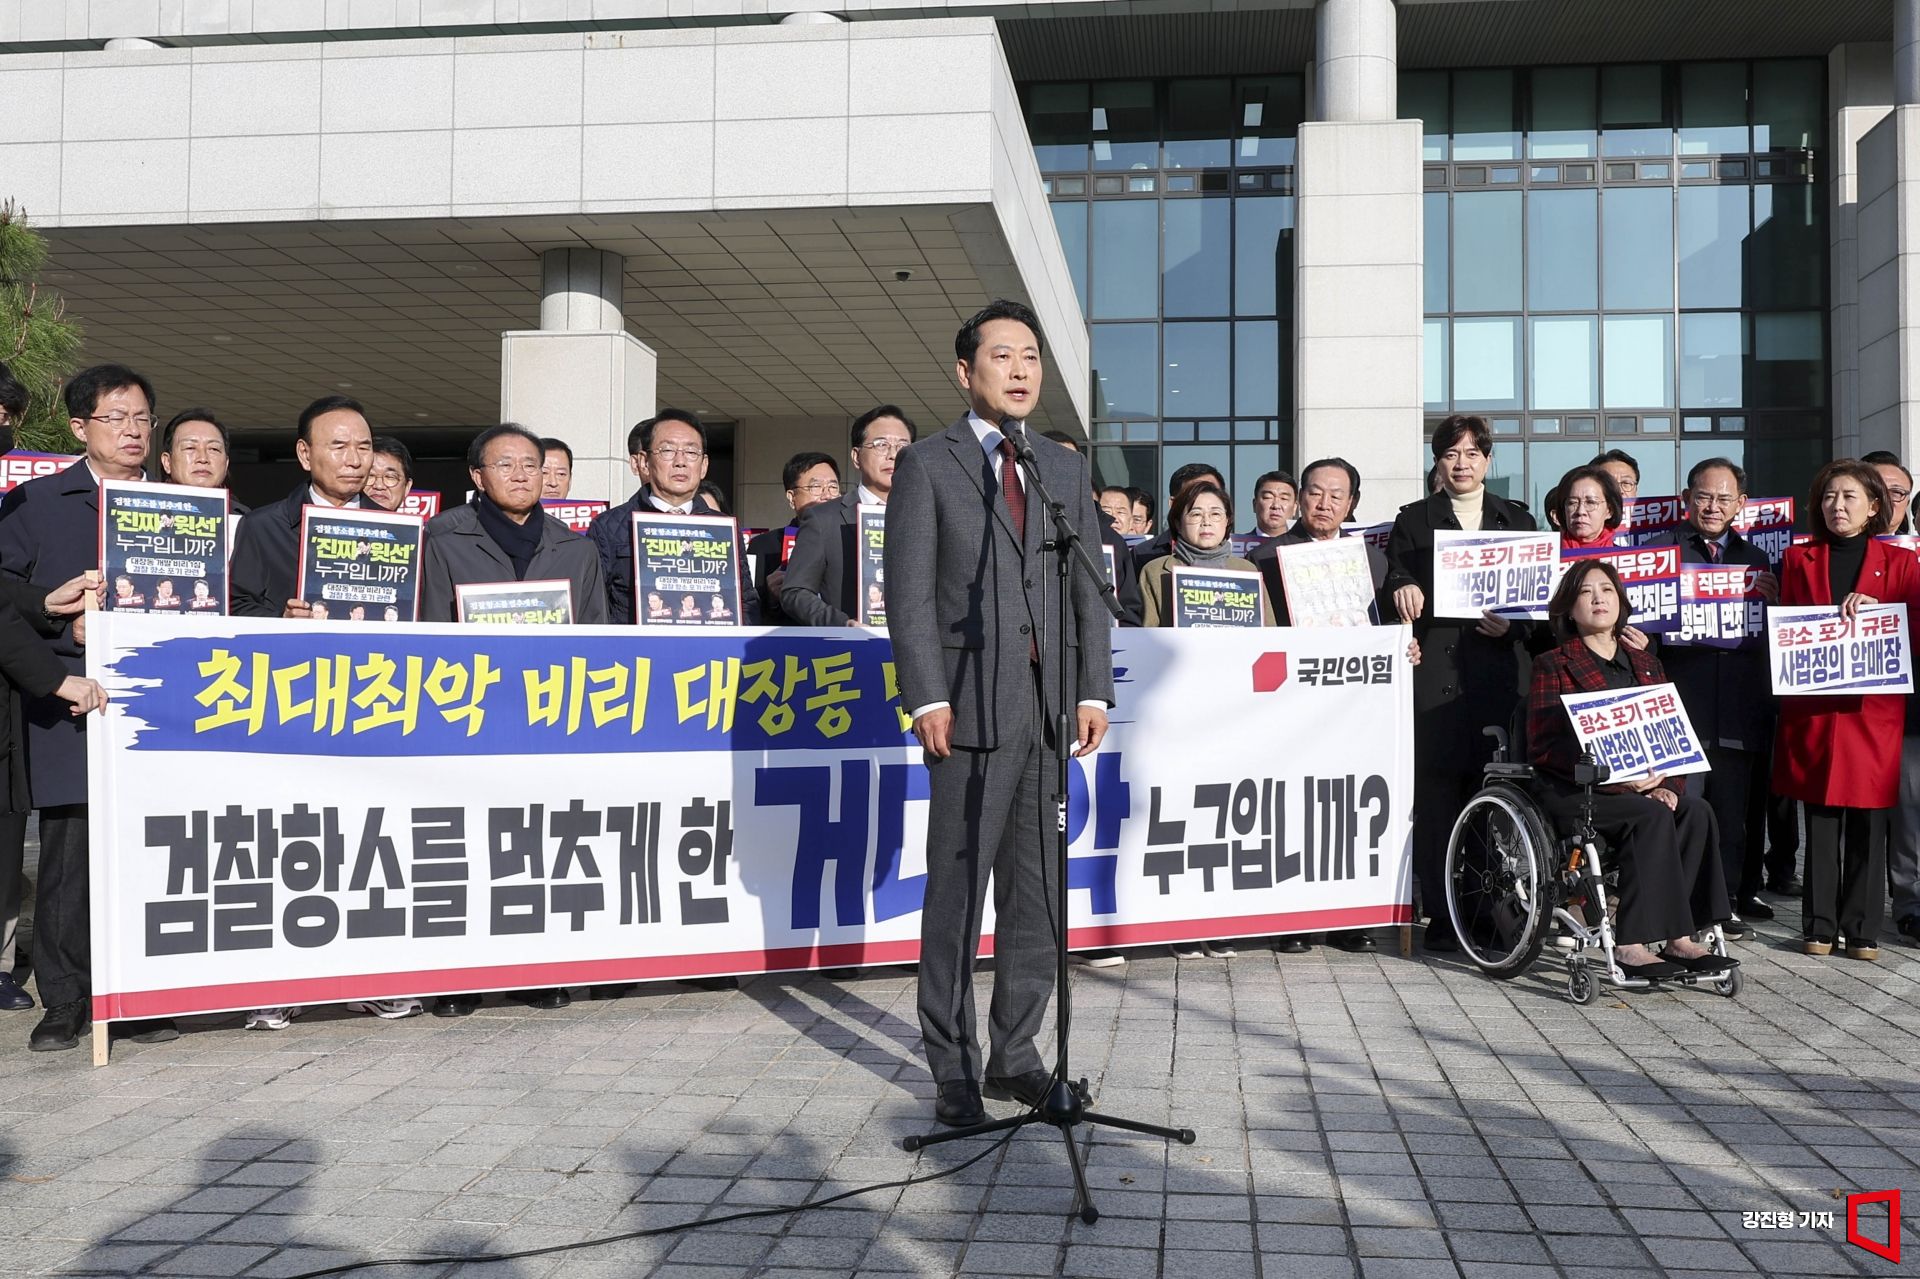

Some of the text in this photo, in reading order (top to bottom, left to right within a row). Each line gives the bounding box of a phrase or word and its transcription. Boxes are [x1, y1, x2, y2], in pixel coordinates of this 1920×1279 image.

[116, 534, 216, 556] 누구입니까?
[1442, 543, 1553, 569] 항소 포기 규탄
[315, 561, 409, 583] 누구입니까?
[647, 558, 728, 574] 누구입니까?
[1506, 564, 1553, 604] 암매장
[1184, 606, 1254, 623] 누구입니까?
[1626, 582, 1678, 625] 면죄부
[1721, 601, 1763, 639] 면죄부
[1777, 614, 1900, 647] 항소 포기 규탄
[1298, 655, 1392, 686] 국민의힘
[1779, 636, 1901, 687] 사법정의 암매장
[194, 649, 501, 737] 최대최악
[522, 656, 650, 736] 비리
[673, 651, 861, 739] 대장동
[1578, 693, 1677, 735] 항소 포기 규탄
[1643, 715, 1692, 761] 암매장
[144, 804, 469, 957] 검찰항소를
[488, 799, 661, 936] 멈추게
[677, 797, 734, 926] 한
[1141, 774, 1391, 896] 누구입니까?
